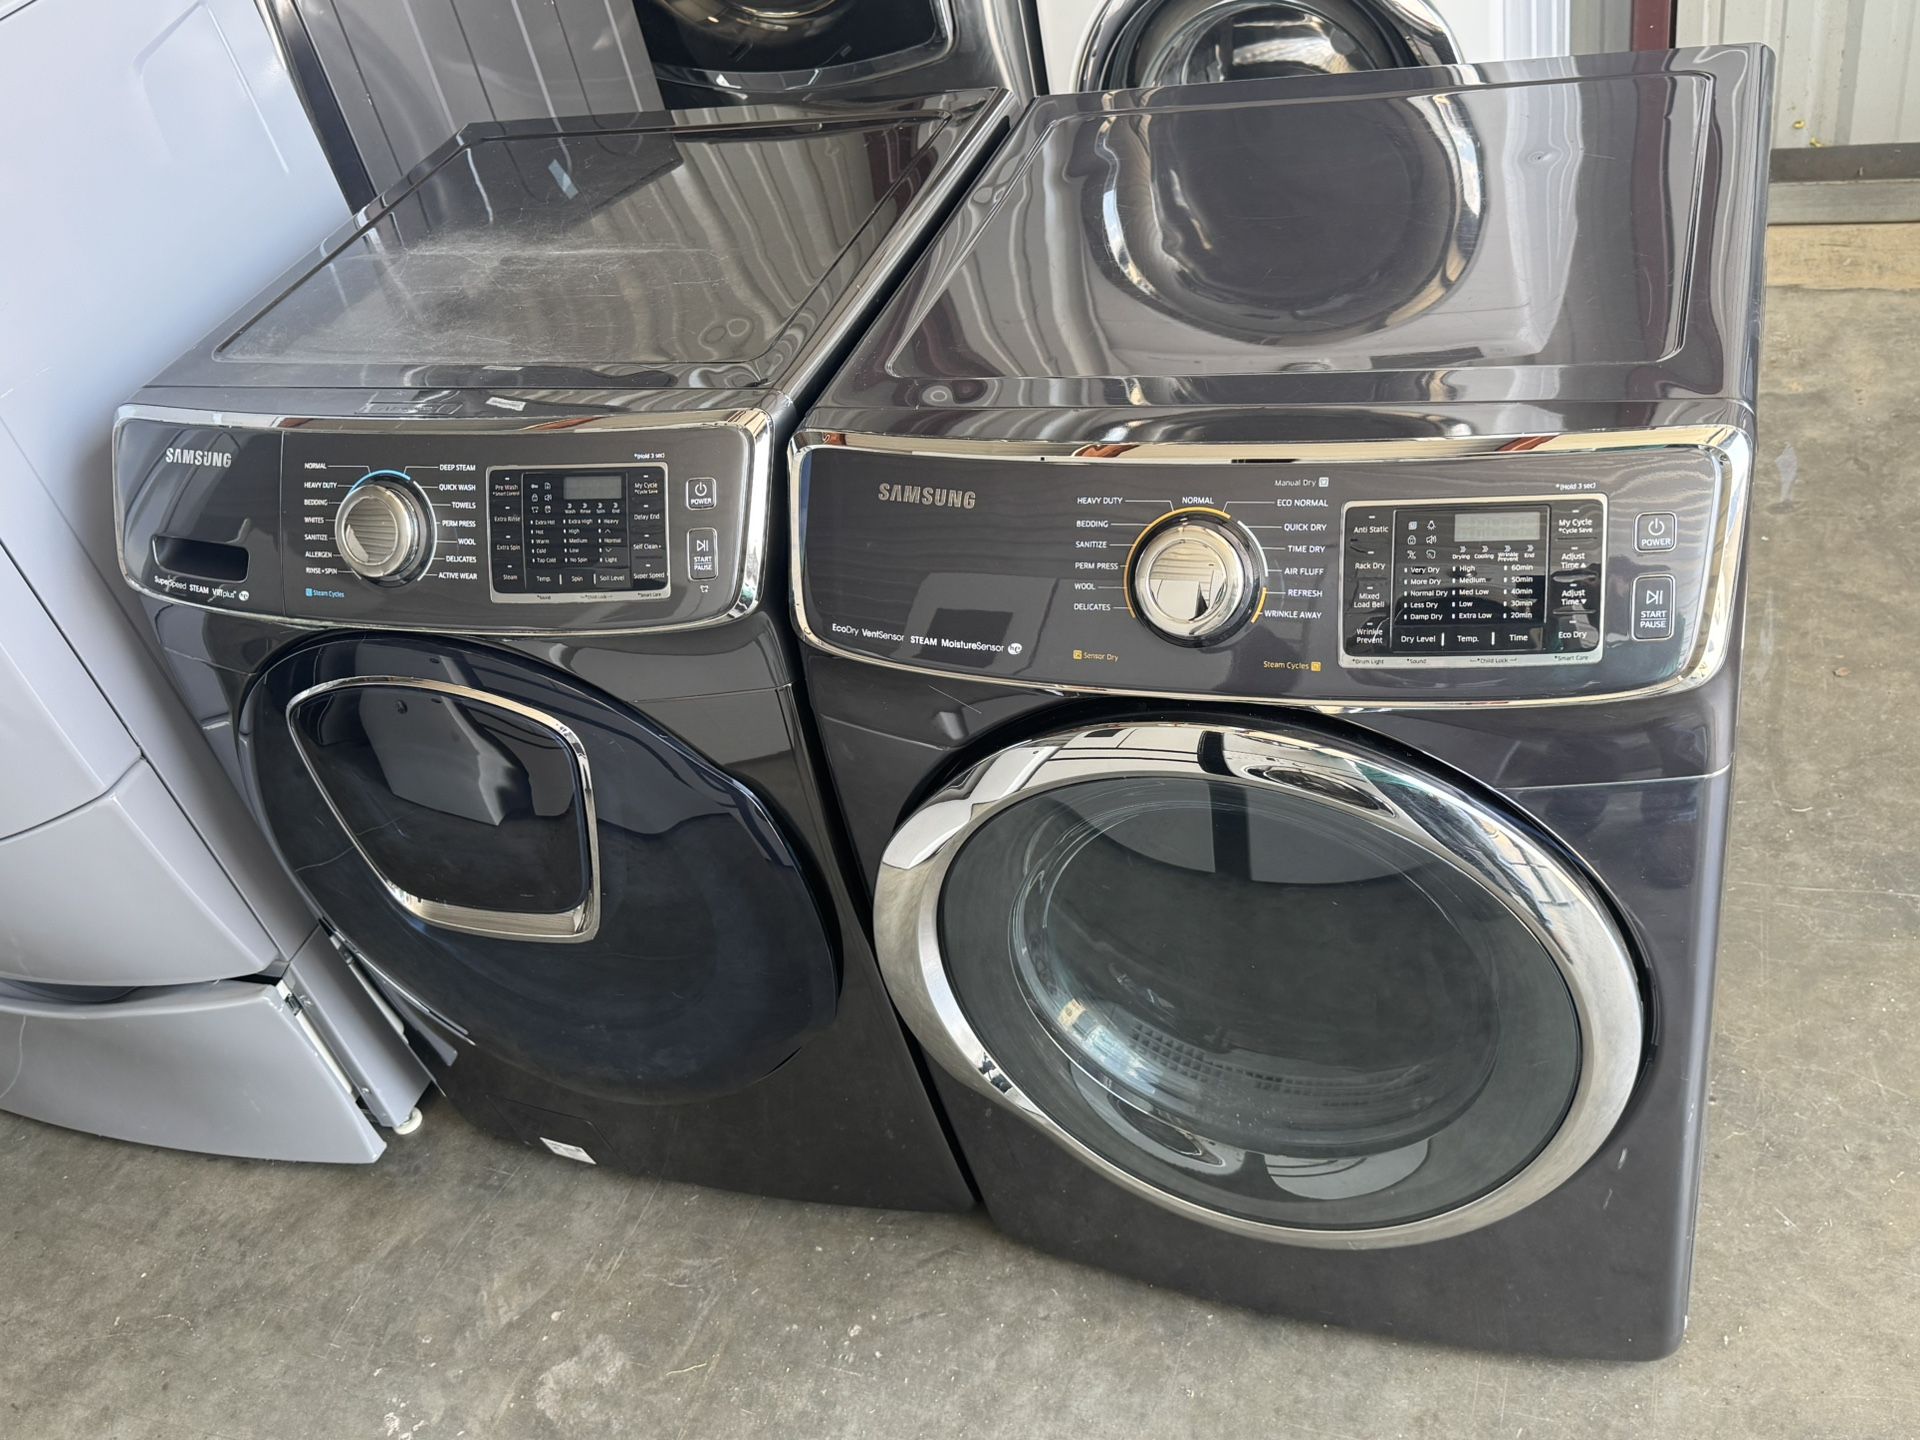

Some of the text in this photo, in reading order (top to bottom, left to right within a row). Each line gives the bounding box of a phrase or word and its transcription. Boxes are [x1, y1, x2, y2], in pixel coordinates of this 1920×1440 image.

[165, 447, 232, 468] SAMSUNG
[1274, 479, 1317, 487] Manual Dry
[878, 482, 976, 509] SAMSUNG
[1077, 497, 1102, 505] HEAVY
[1181, 496, 1214, 504] NORMAL
[1276, 499, 1329, 507] ECO NORMAL
[459, 520, 476, 528] PRESS
[1076, 520, 1109, 528] BEDDING
[1559, 518, 1593, 527] My Cycle
[1283, 523, 1327, 531] QUICK DRY
[1369, 525, 1389, 533] Static
[457, 538, 476, 546] WOOL
[1075, 541, 1107, 549] SANITIZE
[1641, 537, 1671, 547] POWER
[1287, 545, 1326, 553] TIME DRY
[445, 555, 477, 563] DELICATES
[1561, 552, 1586, 561] Adjust
[1096, 562, 1119, 570] PRESS
[1372, 562, 1386, 570] Dry
[1427, 566, 1440, 574] Dry
[1459, 565, 1476, 573] High
[649, 571, 665, 579] Speed
[1284, 567, 1325, 576] AIR FLUFF
[1074, 582, 1096, 590] WOOL
[1428, 578, 1441, 586] Dry
[189, 584, 210, 594] STEAM
[1287, 589, 1323, 597] REFRESH
[329, 590, 345, 598] Cycles
[1561, 589, 1585, 598] Adjust
[1371, 600, 1385, 608] Bell
[1560, 598, 1579, 606] Time
[1073, 603, 1111, 611] DELICATES
[1264, 609, 1322, 619] WRINKLE AWAY
[1640, 610, 1668, 618] START
[1640, 620, 1666, 628] PAUSE
[1356, 628, 1383, 636] Wrinkle
[1558, 631, 1587, 639] Eco Dry
[832, 623, 1005, 653] EcoDry VentSensor STEAM MoistureSensor
[1356, 636, 1383, 644] Prevent
[1401, 635, 1415, 643] Dry
[1083, 652, 1119, 662] Sensor Dry
[1263, 660, 1309, 670] Steam Cycles
